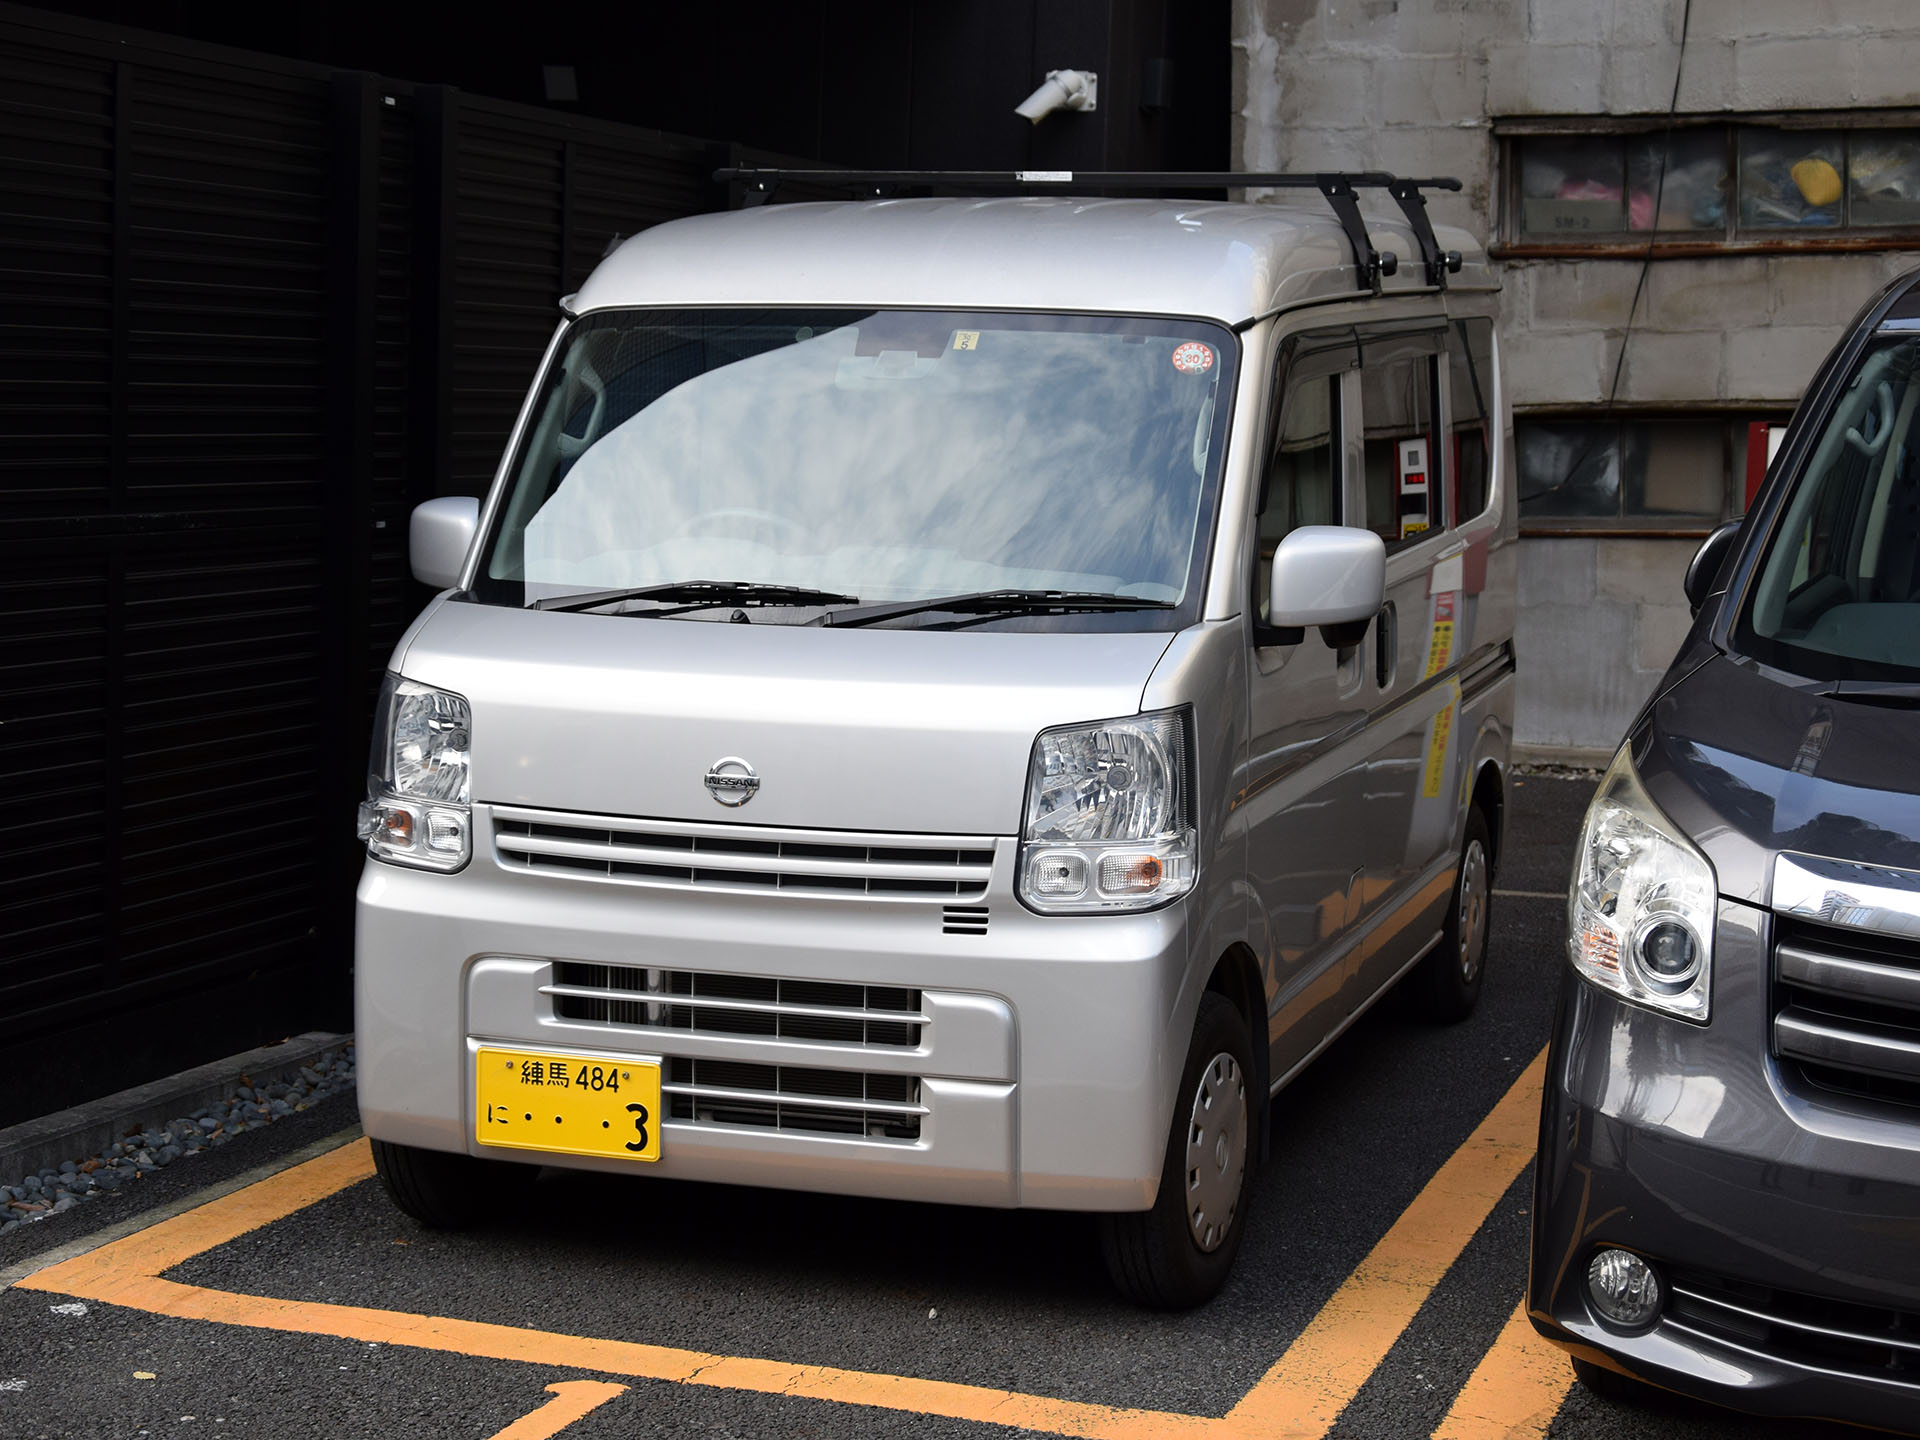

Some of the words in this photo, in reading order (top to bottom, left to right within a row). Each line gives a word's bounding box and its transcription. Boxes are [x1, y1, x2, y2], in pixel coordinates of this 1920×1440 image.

[1185, 353, 1201, 364] 30
[708, 776, 752, 787] NISSAN
[520, 1060, 570, 1088] 練馬
[575, 1065, 620, 1093] 484
